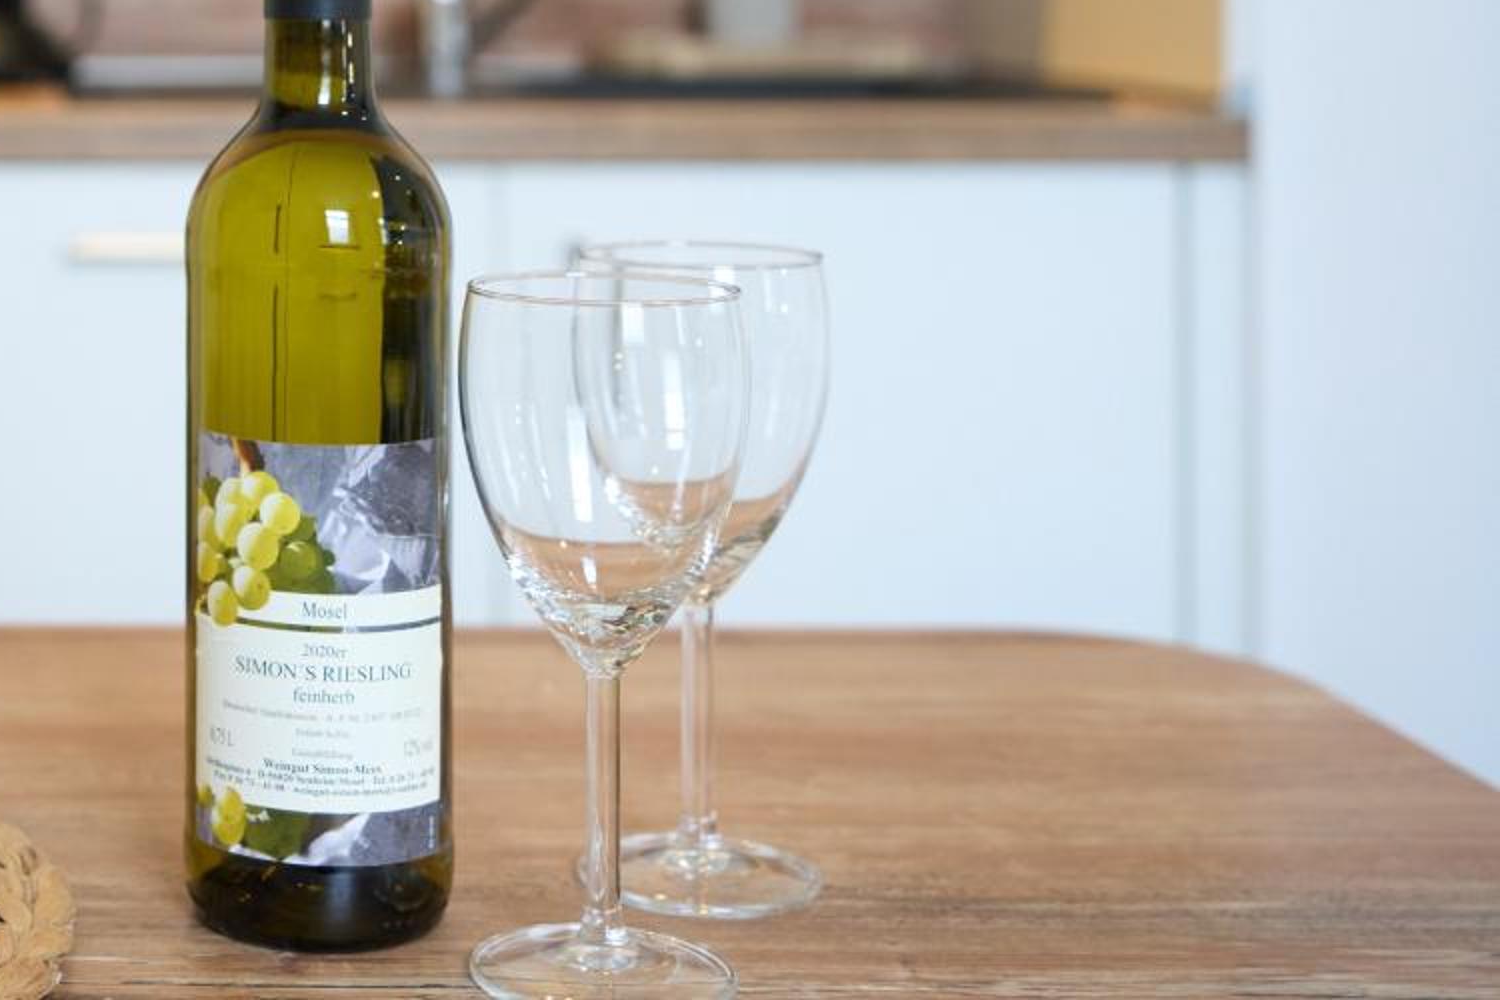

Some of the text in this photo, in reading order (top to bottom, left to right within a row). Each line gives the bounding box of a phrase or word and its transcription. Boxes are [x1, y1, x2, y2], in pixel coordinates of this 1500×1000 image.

[302, 601, 348, 620] Mosel
[301, 643, 348, 659] 2020er
[322, 663, 412, 683] RIESLING
[293, 686, 355, 704] feinherb
[263, 758, 309, 774] Weingut
